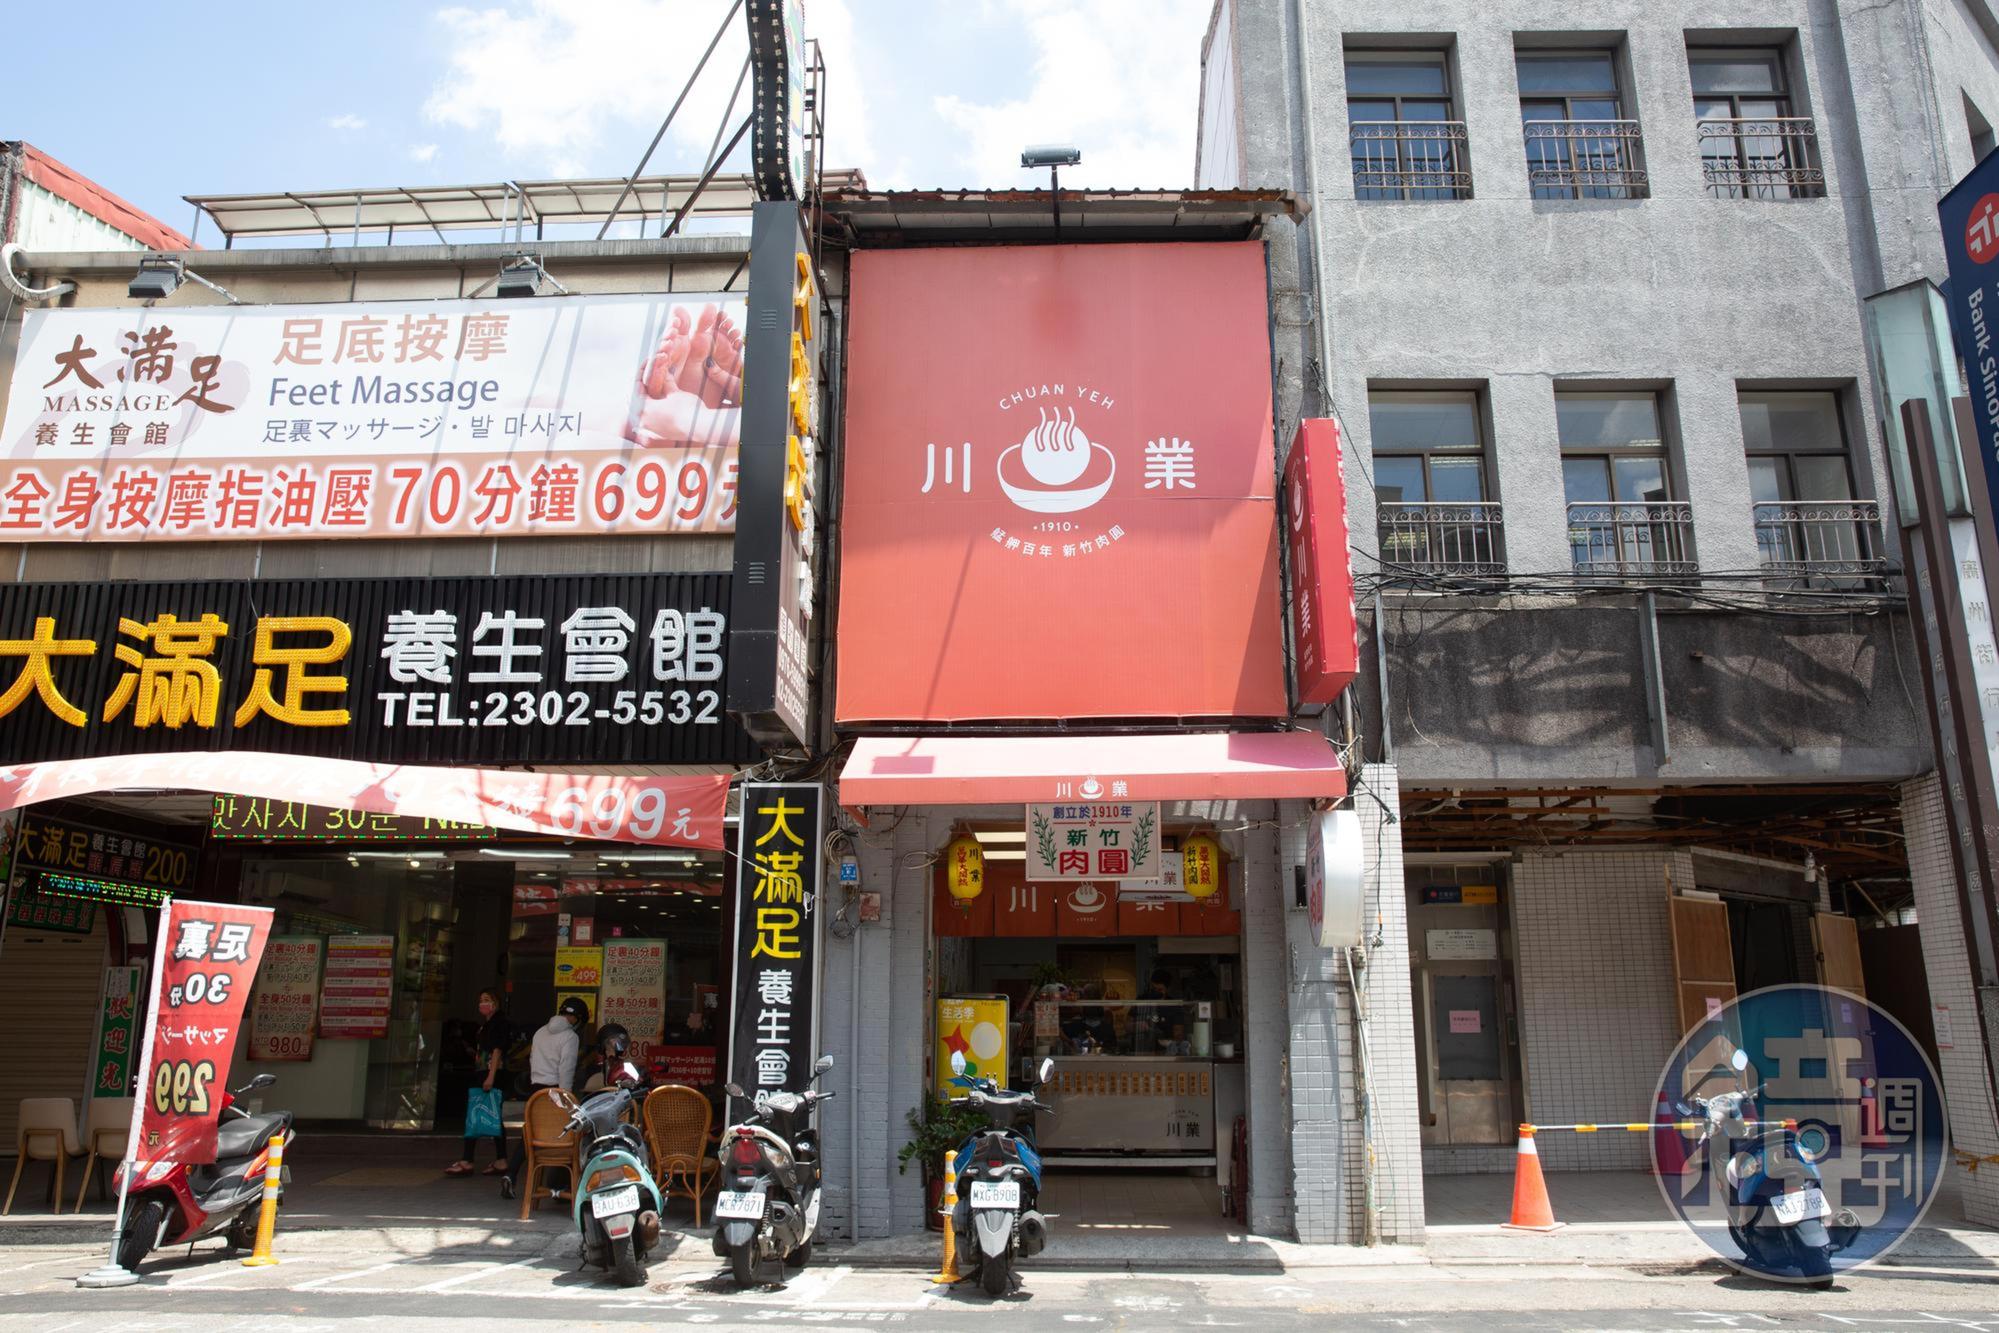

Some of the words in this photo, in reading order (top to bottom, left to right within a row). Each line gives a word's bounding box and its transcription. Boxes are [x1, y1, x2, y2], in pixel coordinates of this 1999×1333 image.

[273, 312, 510, 366] 足底按摩
[42, 325, 235, 413] 大滿足
[1967, 287, 1990, 356] Bank
[1980, 356, 1999, 462] Sino
[43, 395, 170, 412] MASSAGE
[269, 377, 342, 406] Feet
[351, 375, 499, 410] Massage
[999, 384, 1064, 410] CHUAN
[1077, 386, 1115, 410] YEH
[35, 422, 170, 446] 養生會館
[504, 412, 582, 437] 마사지
[922, 442, 971, 493] 川
[1, 468, 371, 531] 全身按摩指油壓
[392, 464, 579, 527] 70分鐘
[1062, 524, 1126, 558] 新竹肉圓
[0, 612, 353, 730] 大滿足
[380, 606, 726, 685] 養生會館
[378, 689, 720, 728] TEL:2302-5532
[1053, 805, 1132, 819] 創立於1910年
[17, 822, 88, 869] 大滿足
[144, 846, 187, 886] 200
[1067, 829, 1120, 847] 新竹
[750, 797, 805, 959] 大滿足
[1060, 849, 1128, 875] 肉圓
